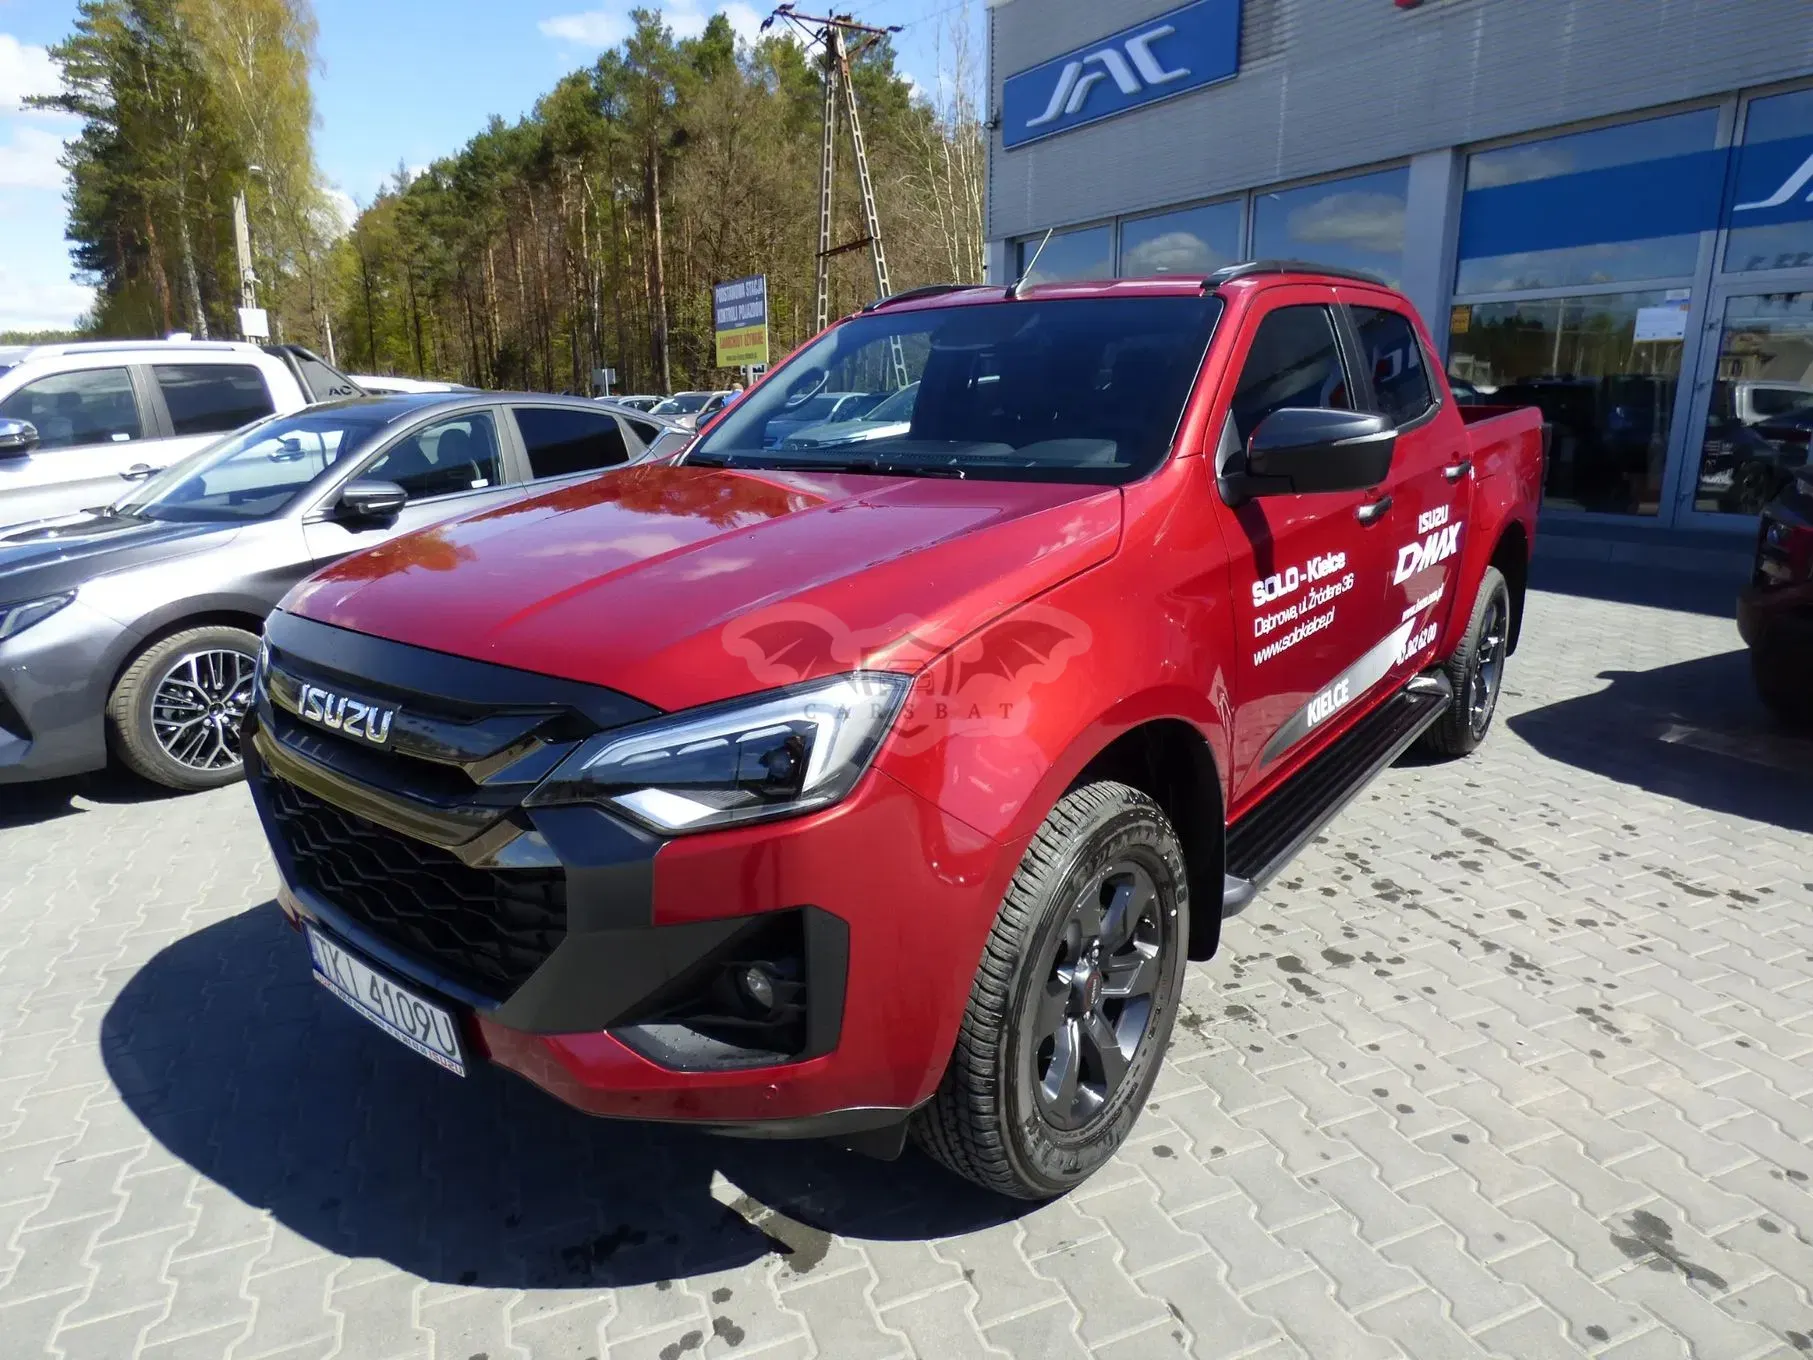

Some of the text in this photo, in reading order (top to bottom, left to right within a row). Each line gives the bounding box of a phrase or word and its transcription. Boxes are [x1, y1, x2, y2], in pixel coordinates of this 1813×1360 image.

[1026, 25, 1191, 127] JAC
[1418, 504, 1449, 534] ISUZU
[1252, 566, 1299, 607] SOLO
[1307, 551, 1346, 583] Kielce
[297, 682, 393, 744] ISUZU
[1307, 678, 1349, 727] KIELCE
[314, 935, 360, 998] TKI
[370, 974, 456, 1056] 4109U
